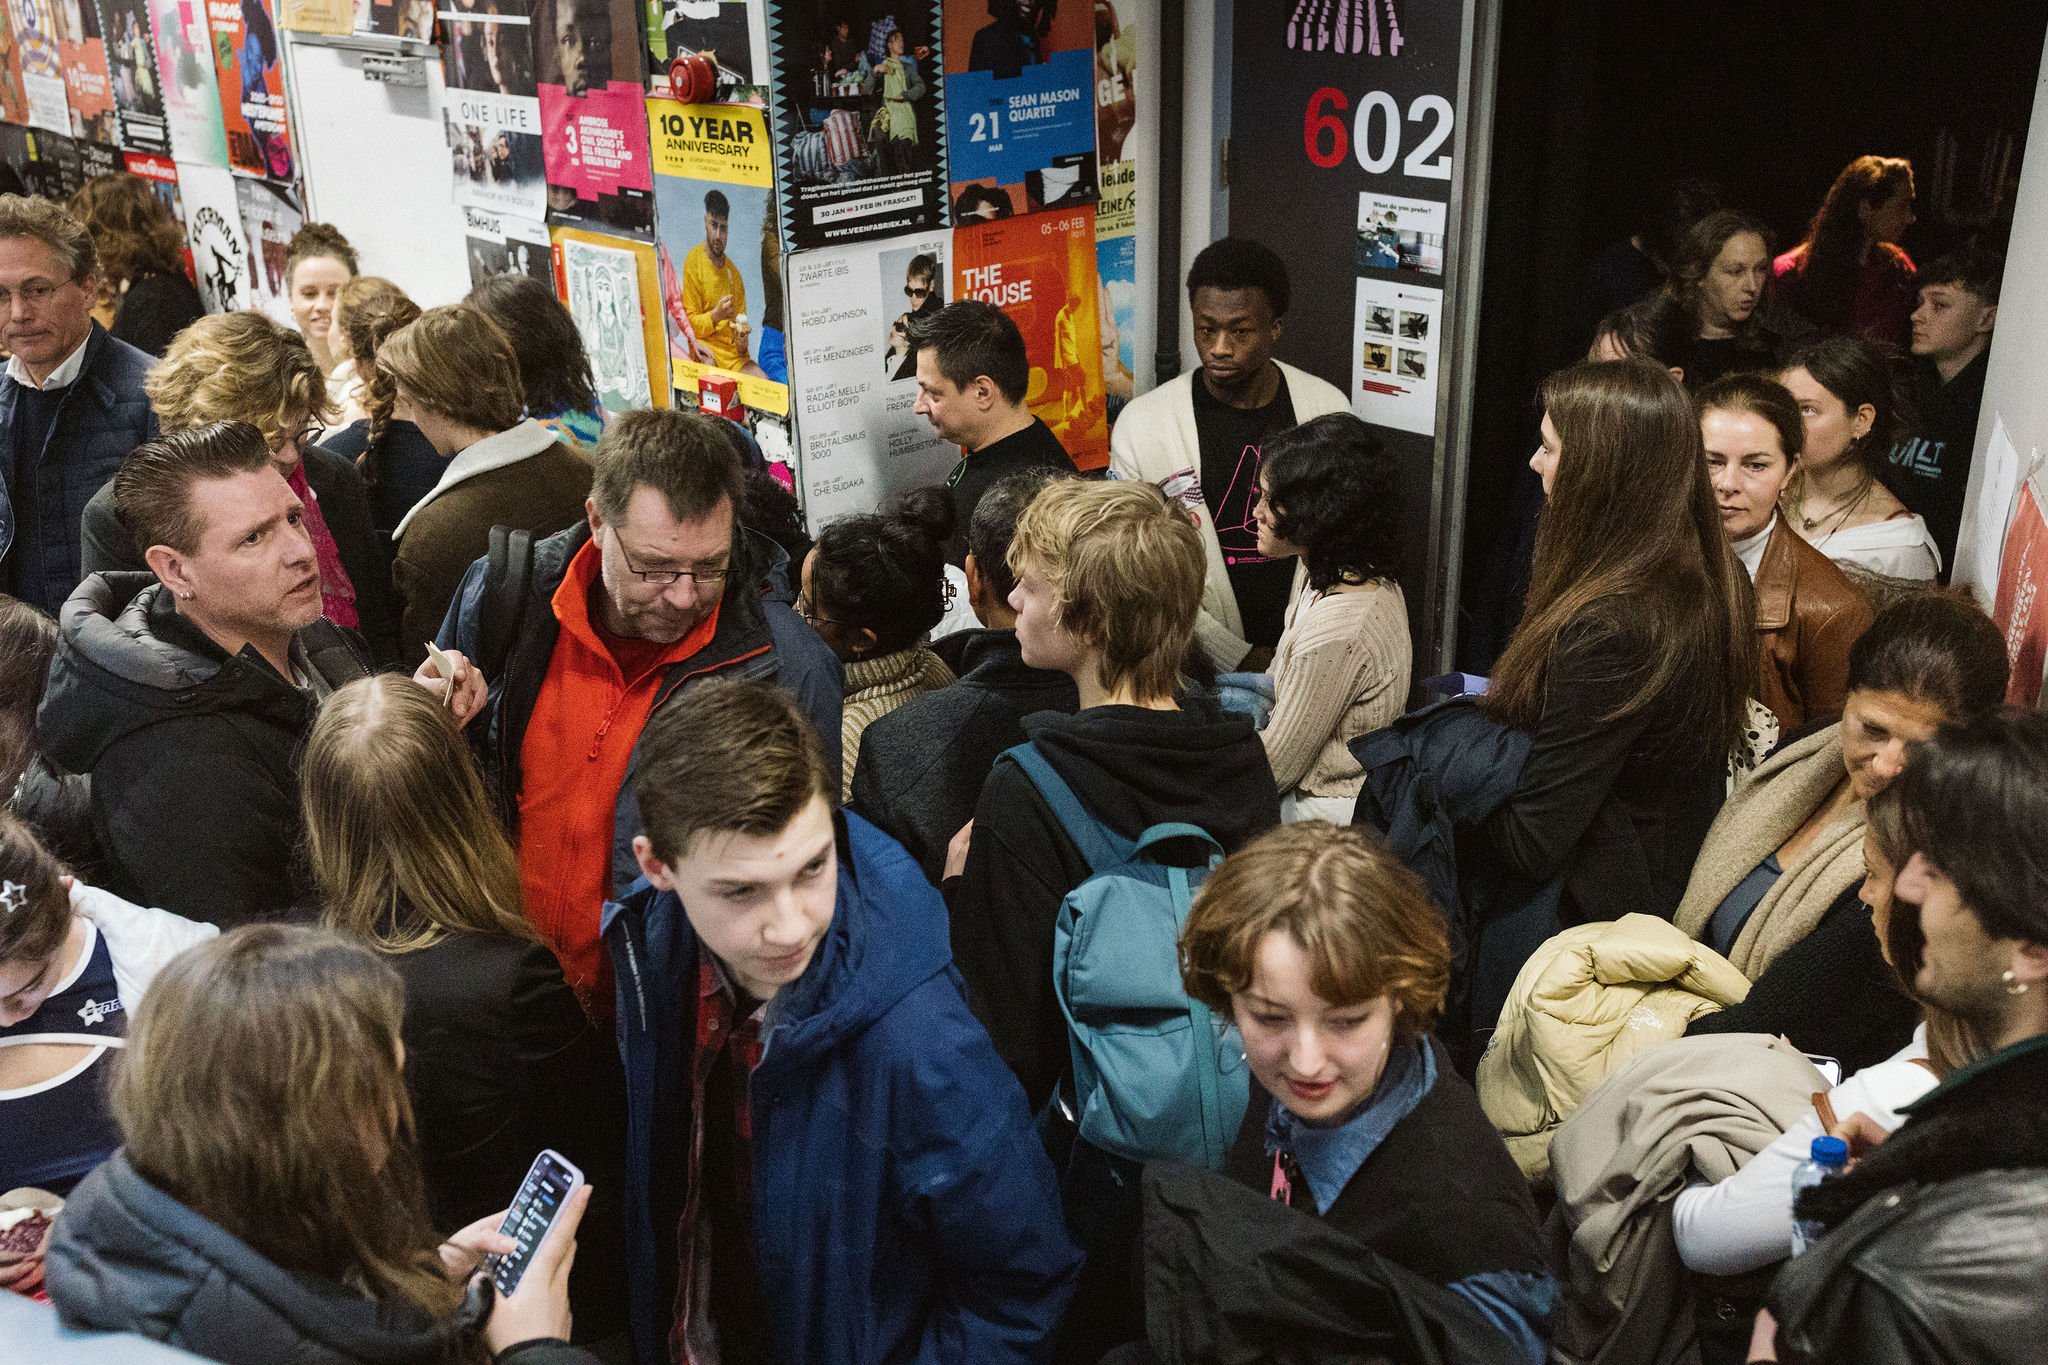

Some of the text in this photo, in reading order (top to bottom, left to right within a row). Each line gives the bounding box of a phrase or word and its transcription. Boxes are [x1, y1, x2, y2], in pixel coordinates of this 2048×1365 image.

[1009, 88, 1080, 109] SEAN MASON
[461, 103, 527, 127] ONE LIFE
[1009, 105, 1056, 122] QUARTET
[660, 114, 754, 144] 10 YEAR
[969, 111, 999, 143] 21
[1304, 87, 1454, 181] 602
[565, 125, 578, 154] 3
[667, 138, 750, 158] ANNIVERSARY
[831, 208, 845, 216] JAN
[883, 195, 917, 206] FRASCATI
[1373, 201, 1388, 209] What
[1411, 206, 1432, 214] prefer?
[1071, 217, 1085, 229] FEB
[800, 265, 849, 282] ZWARTE IBIS
[962, 263, 1002, 290] THE
[801, 308, 867, 327] HOBO JOHNSON
[804, 344, 874, 365] THE MENZINGERS
[839, 383, 866, 396] MELLIE
[807, 395, 859, 413] ELLIOT BOYD
[810, 431, 866, 451] BRUTALISMUS
[889, 435, 913, 448] HOLLY
[889, 438, 944, 458] HUMBERSTONE
[811, 449, 832, 461] 3000
[814, 478, 865, 497] CHE SUDAKA
